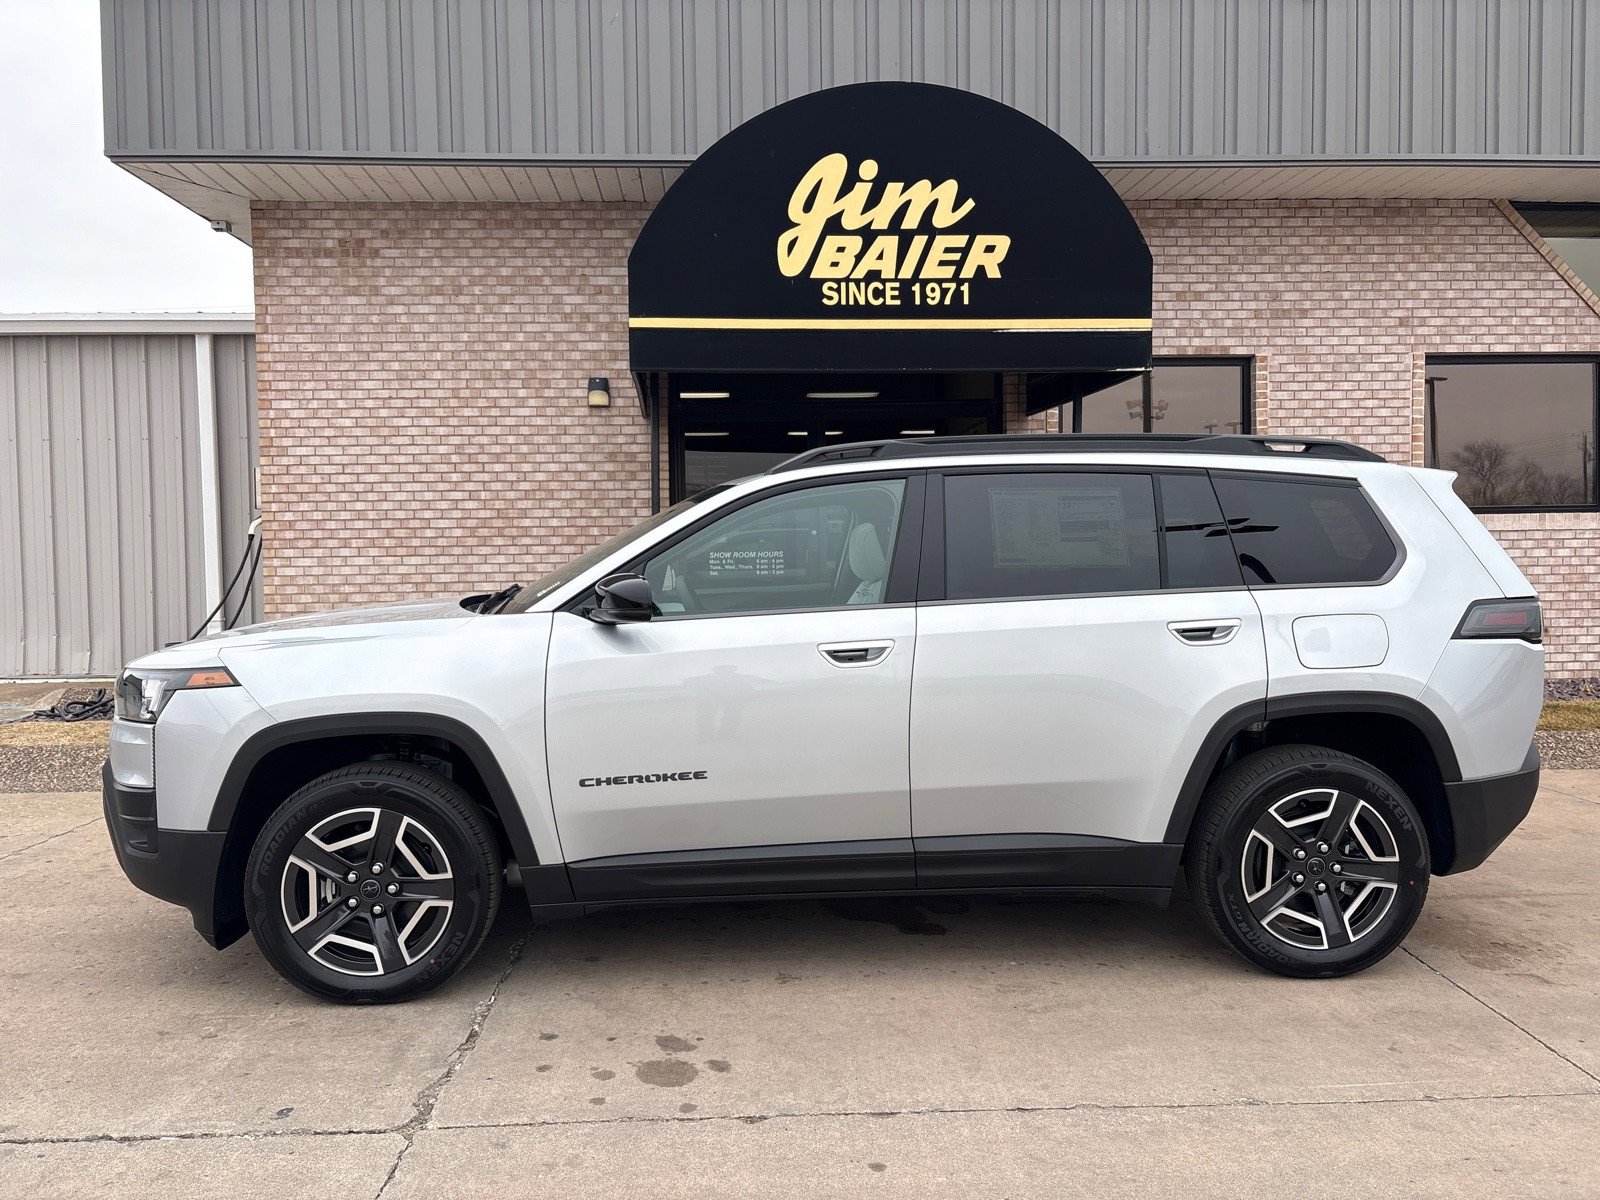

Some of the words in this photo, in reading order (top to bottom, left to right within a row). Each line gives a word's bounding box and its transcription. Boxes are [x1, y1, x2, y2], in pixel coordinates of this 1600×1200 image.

[777, 153, 976, 277] Jim
[810, 235, 1011, 279] BAIER
[822, 282, 901, 305] SINCE
[912, 283, 970, 305] 1971
[579, 770, 708, 788] CHEROKEE
[1365, 781, 1412, 830] NEXEN
[260, 806, 307, 876] ROADIAN
